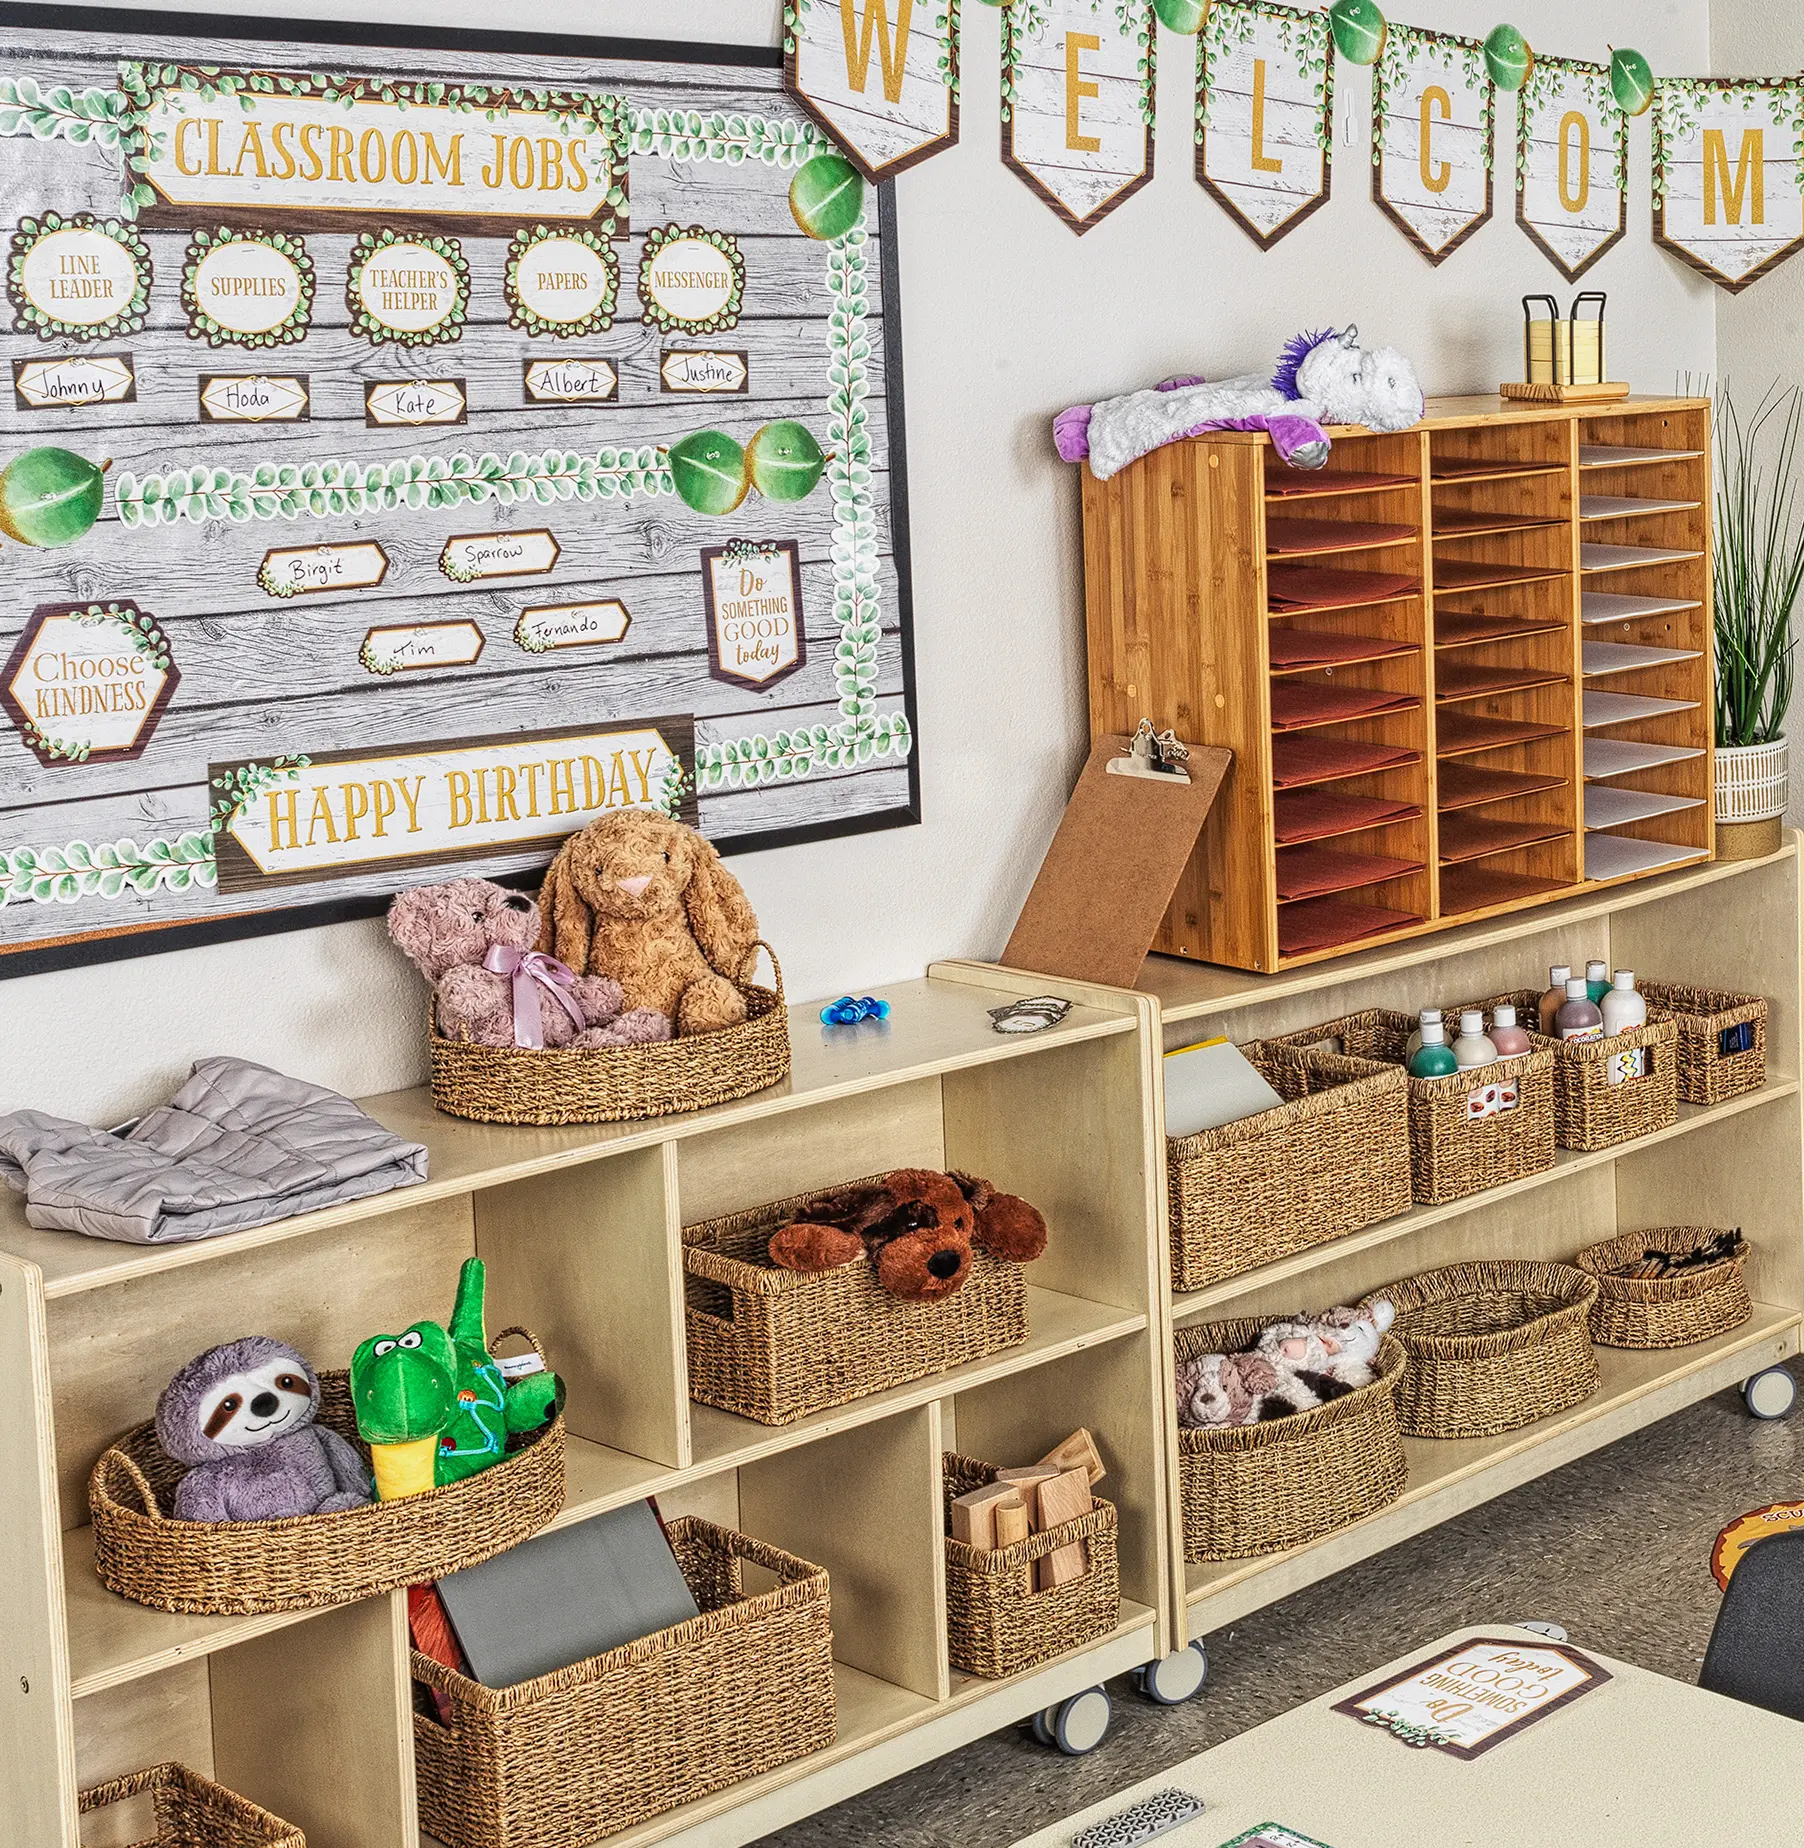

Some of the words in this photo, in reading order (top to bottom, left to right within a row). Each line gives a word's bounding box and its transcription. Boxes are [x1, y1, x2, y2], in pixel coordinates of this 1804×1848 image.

[174, 116, 466, 186] CLASSROOM
[481, 133, 589, 193] JOBS
[60, 254, 101, 276] LINE
[49, 277, 114, 300] LEADER
[210, 276, 287, 298] SUPPLIES
[369, 268, 449, 289] TEACHER'S
[537, 271, 588, 291] PAPERS
[653, 270, 729, 290] MESSENGER
[381, 291, 438, 311] HELPER
[539, 370, 600, 394] Albert
[681, 357, 734, 383] Justine
[40, 367, 105, 401] Johnny
[225, 383, 270, 409] Hoda
[395, 391, 437, 416] Kate
[464, 545, 524, 564] Sparrow
[288, 559, 344, 585] Birgit
[738, 567, 768, 597] Do
[721, 596, 789, 621] SOMETHING
[531, 619, 598, 638] Fernando
[723, 616, 790, 642] GOOD
[393, 641, 436, 657] Tim
[736, 639, 780, 666] today
[33, 652, 146, 683] Choose
[35, 680, 147, 719] KINDNESS
[263, 774, 426, 854] HAPPY
[444, 747, 658, 830] BIRTHDAY
[1488, 1650, 1565, 1682] today
[1419, 1672, 1528, 1714] SOMETHING
[1446, 1661, 1550, 1700] GOOD
[1426, 1698, 1474, 1724] Do
